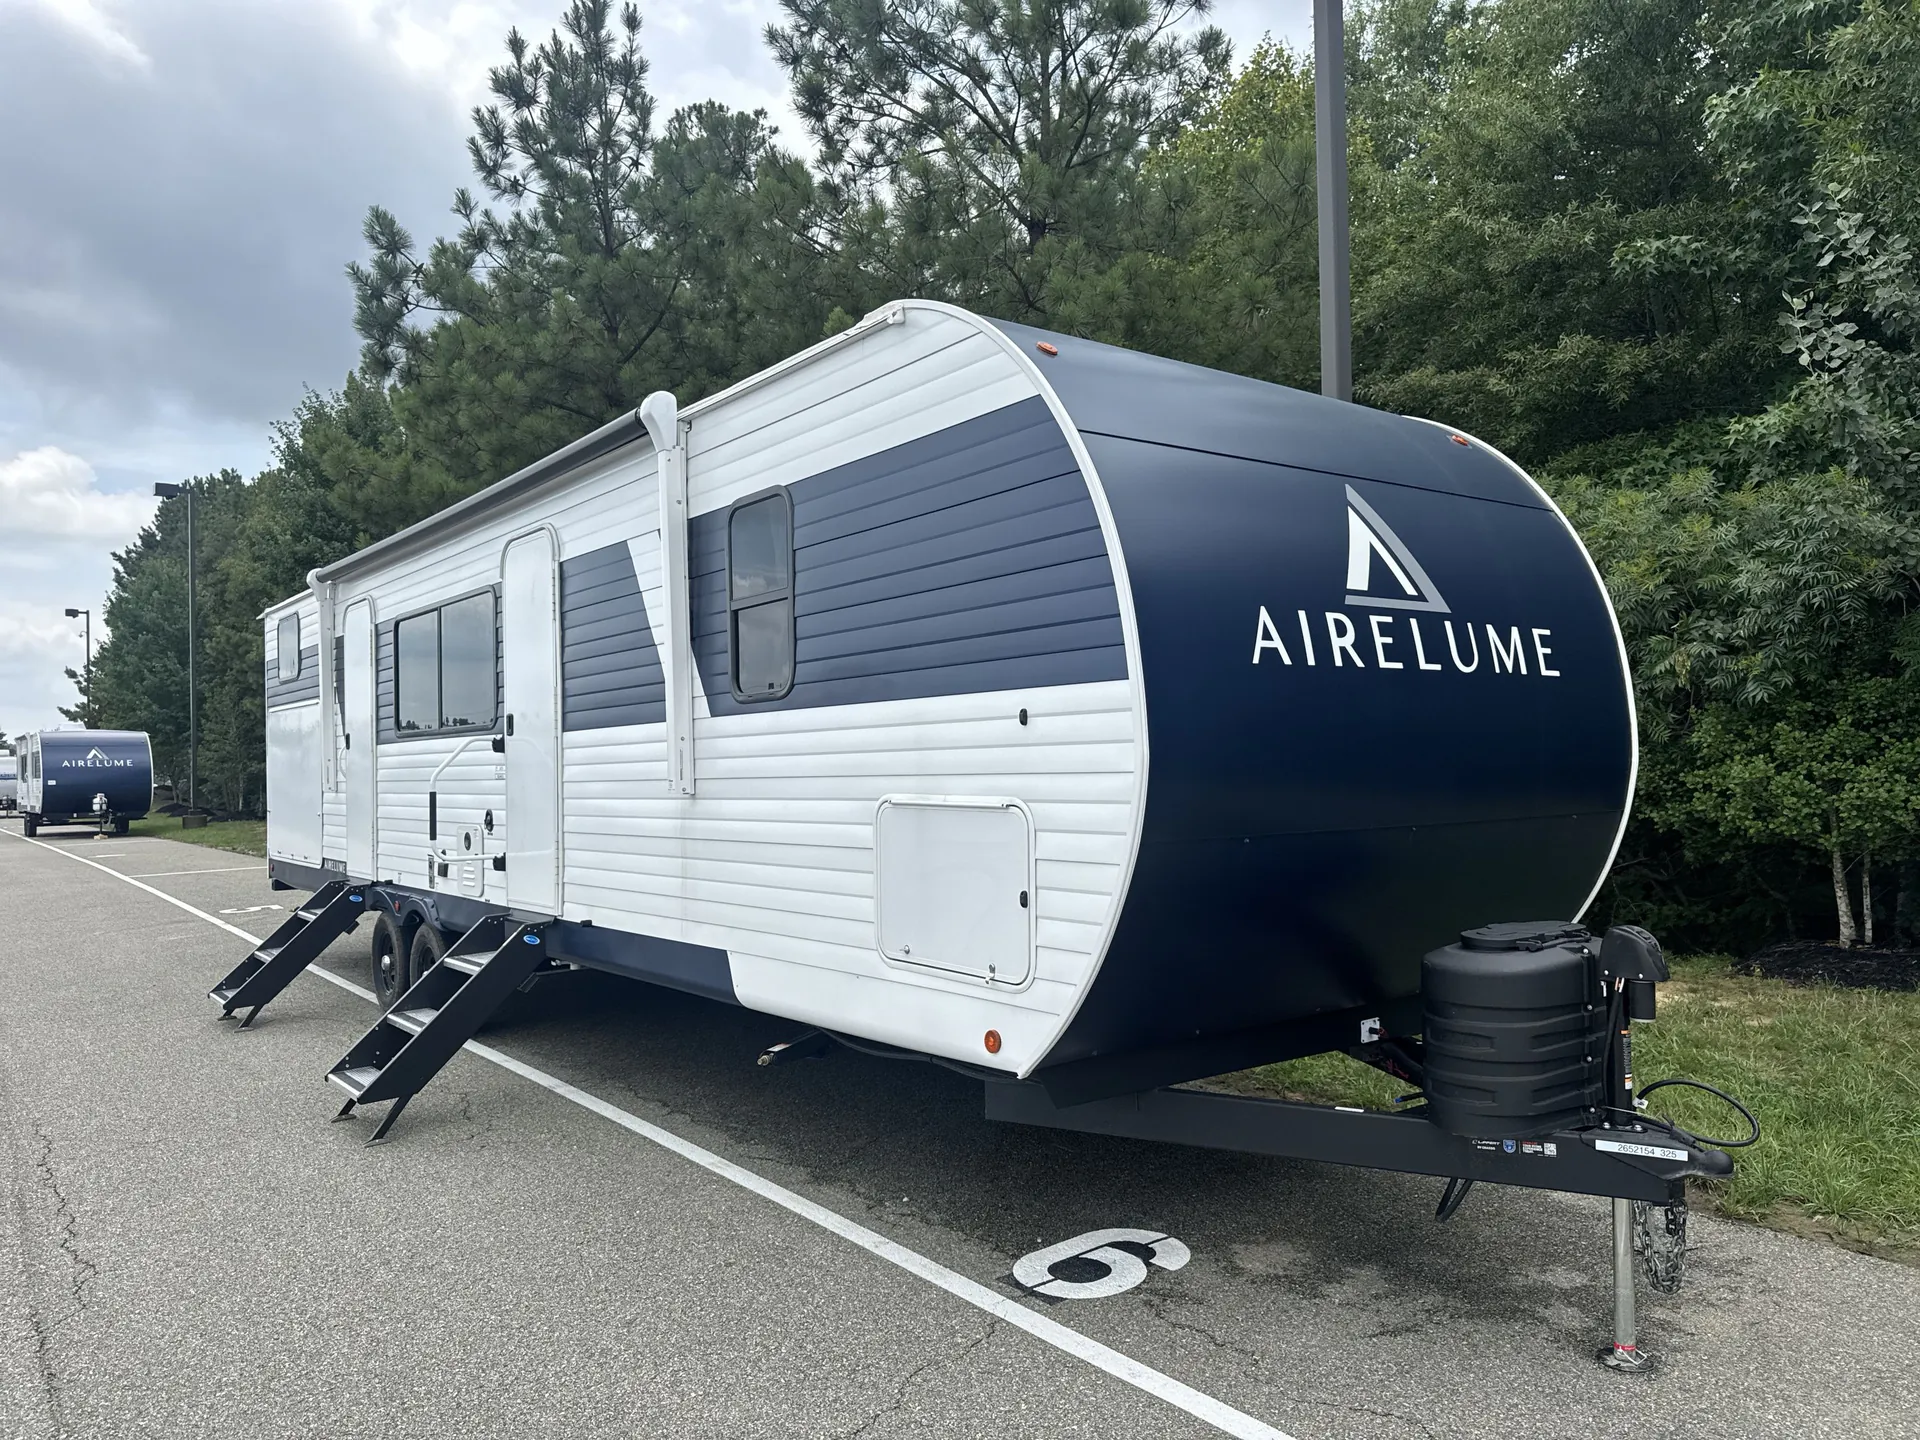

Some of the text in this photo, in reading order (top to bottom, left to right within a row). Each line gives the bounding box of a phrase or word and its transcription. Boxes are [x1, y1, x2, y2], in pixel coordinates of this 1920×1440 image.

[1252, 605, 1561, 677] AIRELUME
[61, 759, 134, 768] AIRELUME
[1617, 1143, 1677, 1159] 2652154 325
[1012, 1228, 1191, 1299] 6
